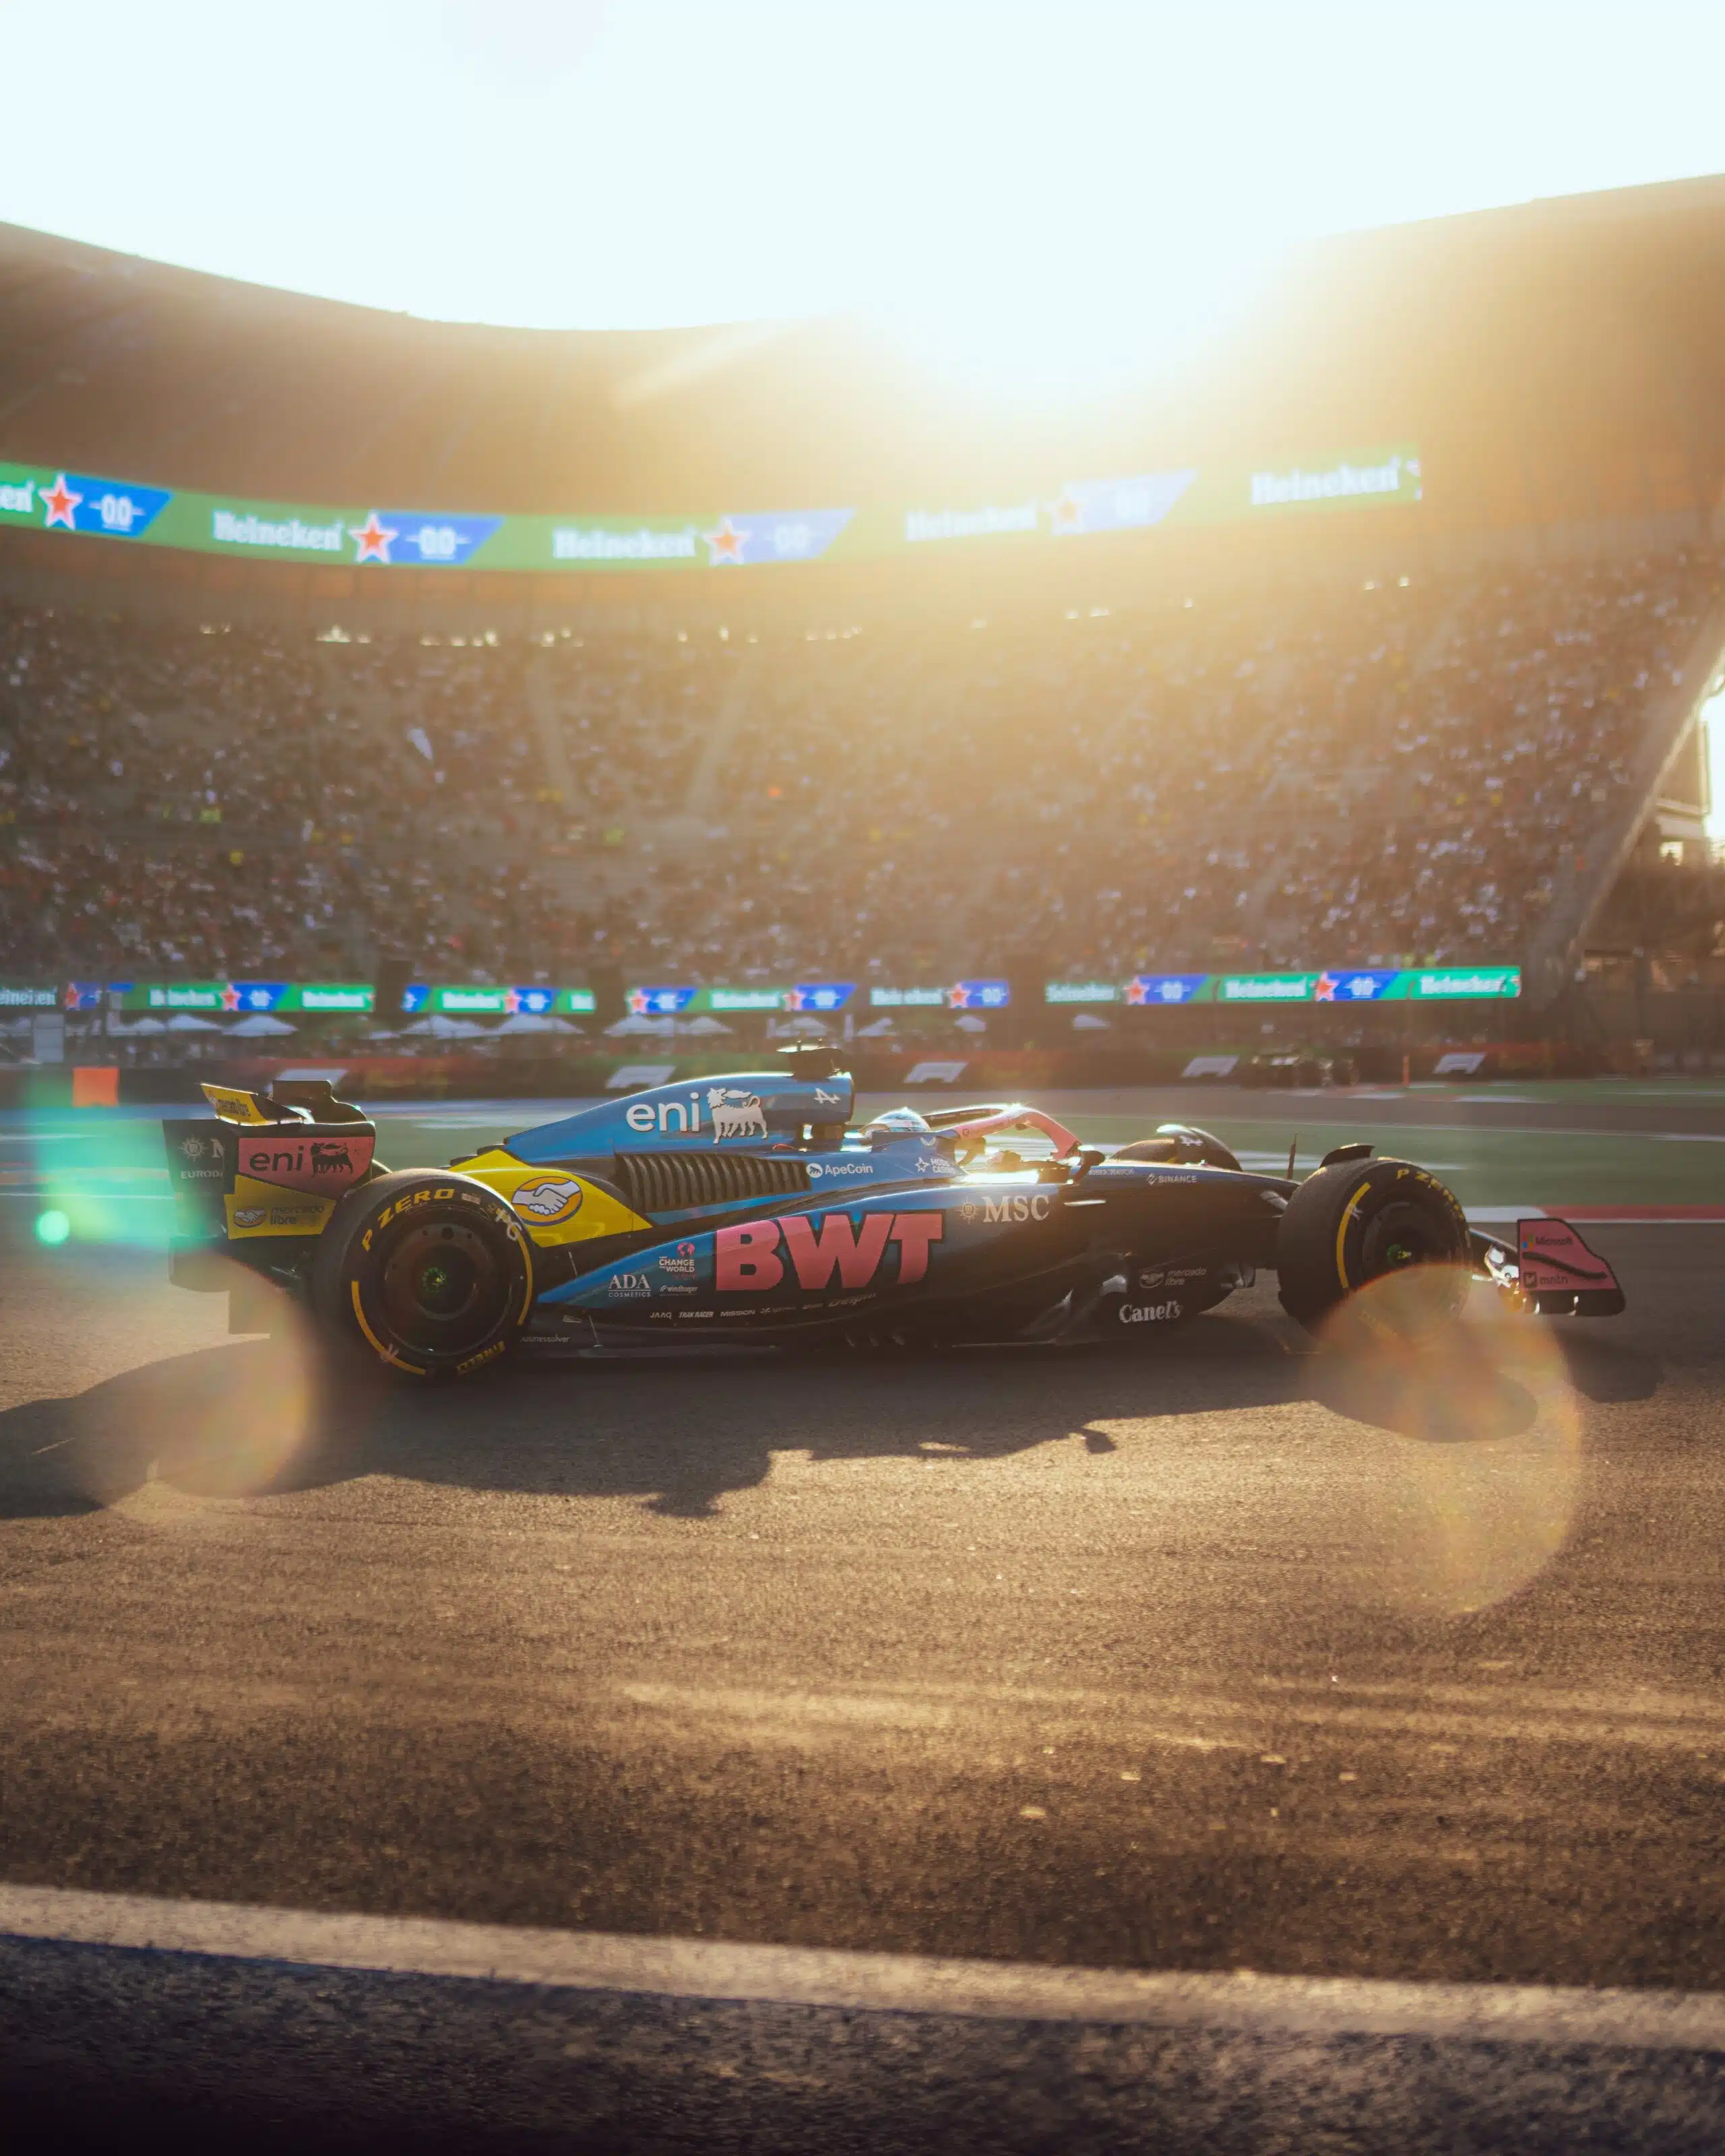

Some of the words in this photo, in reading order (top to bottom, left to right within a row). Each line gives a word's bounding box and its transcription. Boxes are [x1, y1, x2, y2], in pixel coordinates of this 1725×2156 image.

[213, 510, 342, 551] Heineken
[626, 1092, 699, 1132] eni
[249, 1145, 303, 1171] eni
[825, 1164, 873, 1175] ApeCoin
[1158, 1175, 1197, 1183] BINANCE
[377, 1188, 455, 1230] ZERO
[982, 1195, 1050, 1223] MSC
[716, 1212, 943, 1291] BWT
[608, 1274, 651, 1289] ADA
[720, 1309, 755, 1317] MISSION
[1119, 1300, 1182, 1323] Canel's
